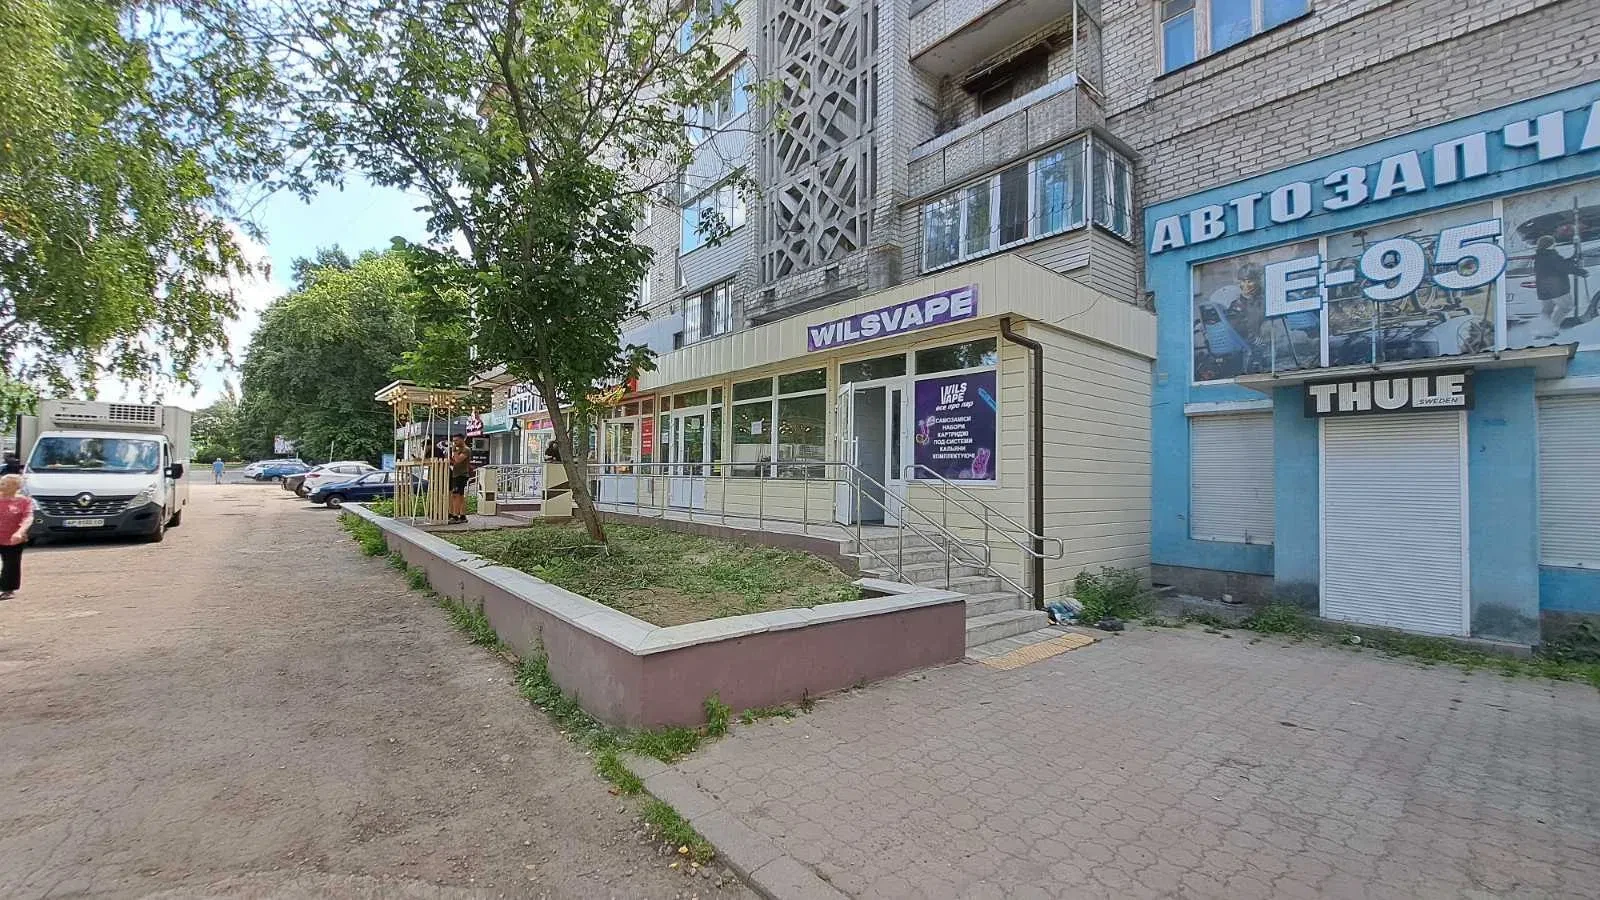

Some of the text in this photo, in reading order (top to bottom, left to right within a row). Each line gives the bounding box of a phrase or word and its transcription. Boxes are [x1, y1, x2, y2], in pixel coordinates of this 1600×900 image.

[810, 289, 973, 348] WILSVAPE
[941, 382, 967, 397] WILS
[1309, 374, 1465, 413] THULE
[941, 391, 964, 404] VAPE
[1417, 397, 1459, 406] SWEDEN
